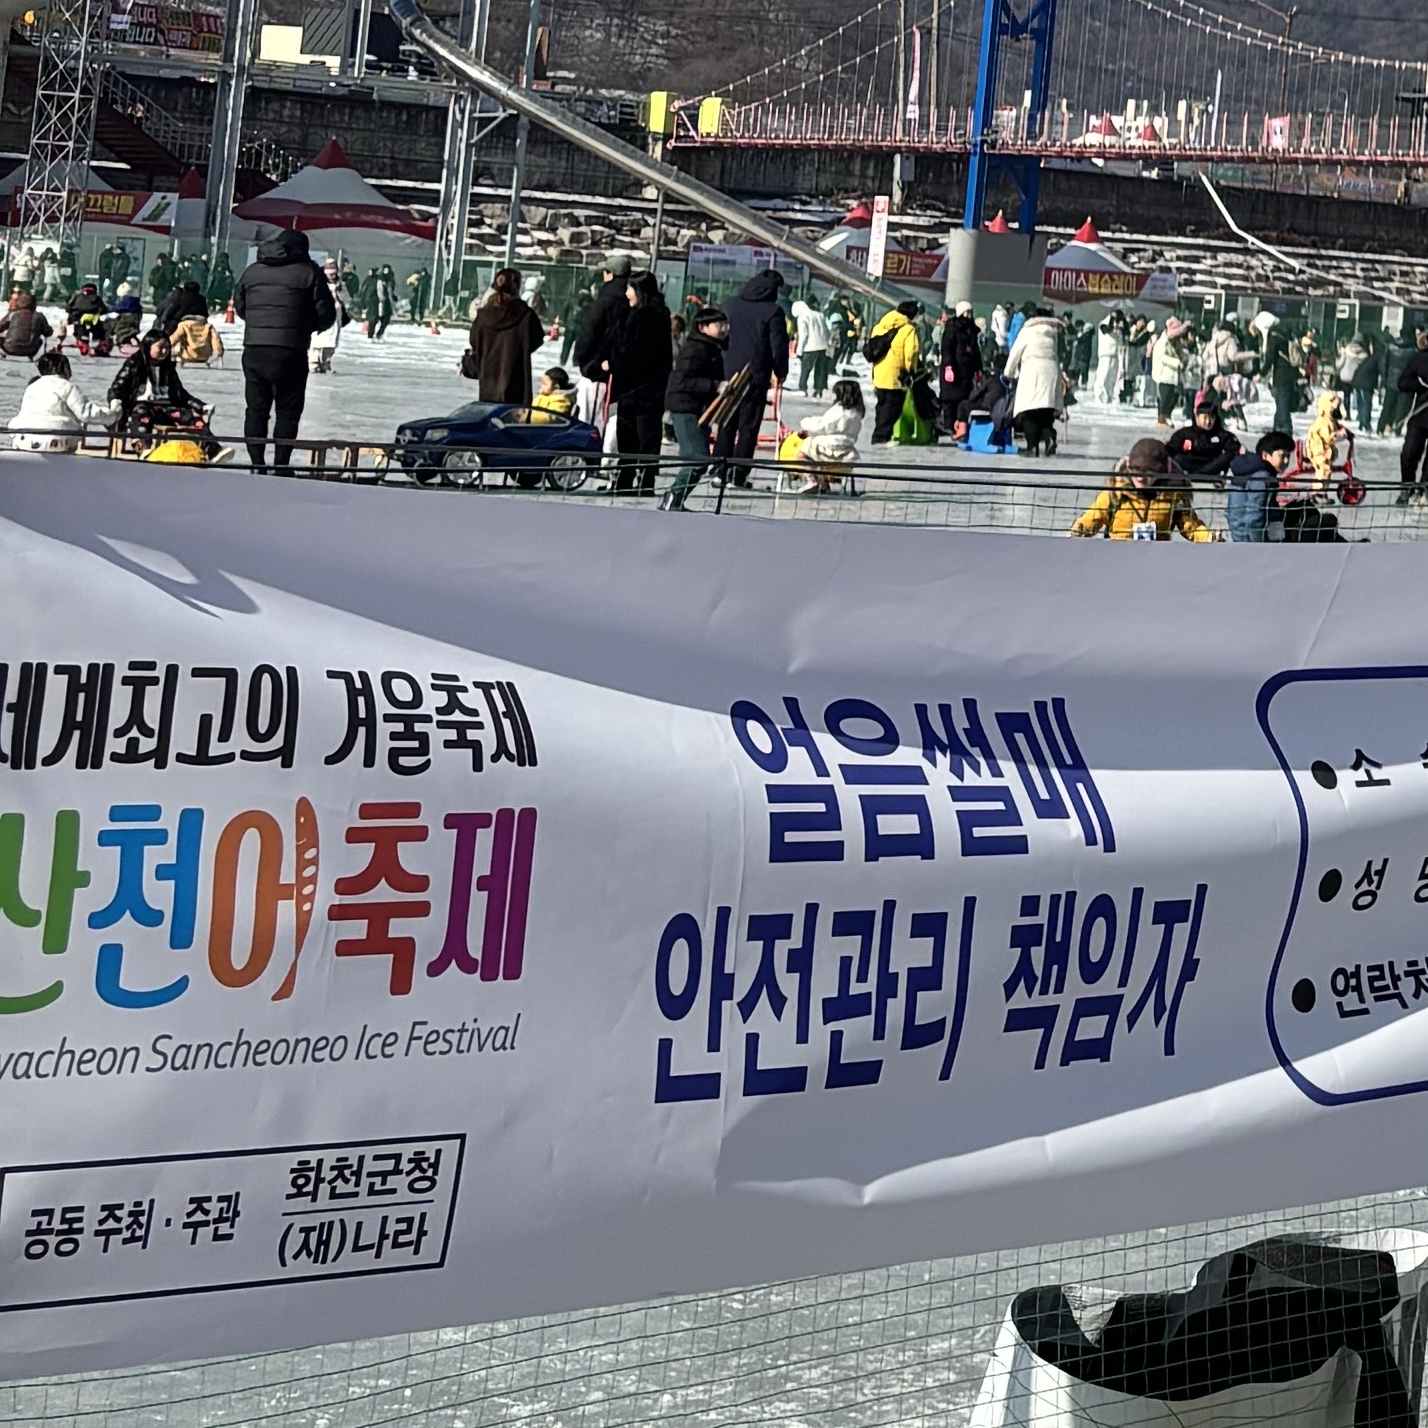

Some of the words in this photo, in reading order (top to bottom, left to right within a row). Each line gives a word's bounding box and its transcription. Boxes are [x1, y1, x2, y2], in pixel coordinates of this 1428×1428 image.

[324, 669, 538, 776] 겨울축제
[729, 696, 1117, 863] 얼음썰매
[654, 895, 978, 1104] 안전관리
[1002, 883, 1209, 1070] 책임자
[145, 1028, 346, 1073] Sancheoneo
[354, 1024, 399, 1060] Ice
[404, 1013, 522, 1058] Festival
[285, 1148, 443, 1203] 화천군청
[23, 1203, 86, 1260] 공동
[93, 1199, 154, 1253] 주최
[181, 1191, 241, 1246] 주관
[277, 1212, 428, 1268] (재)나라
